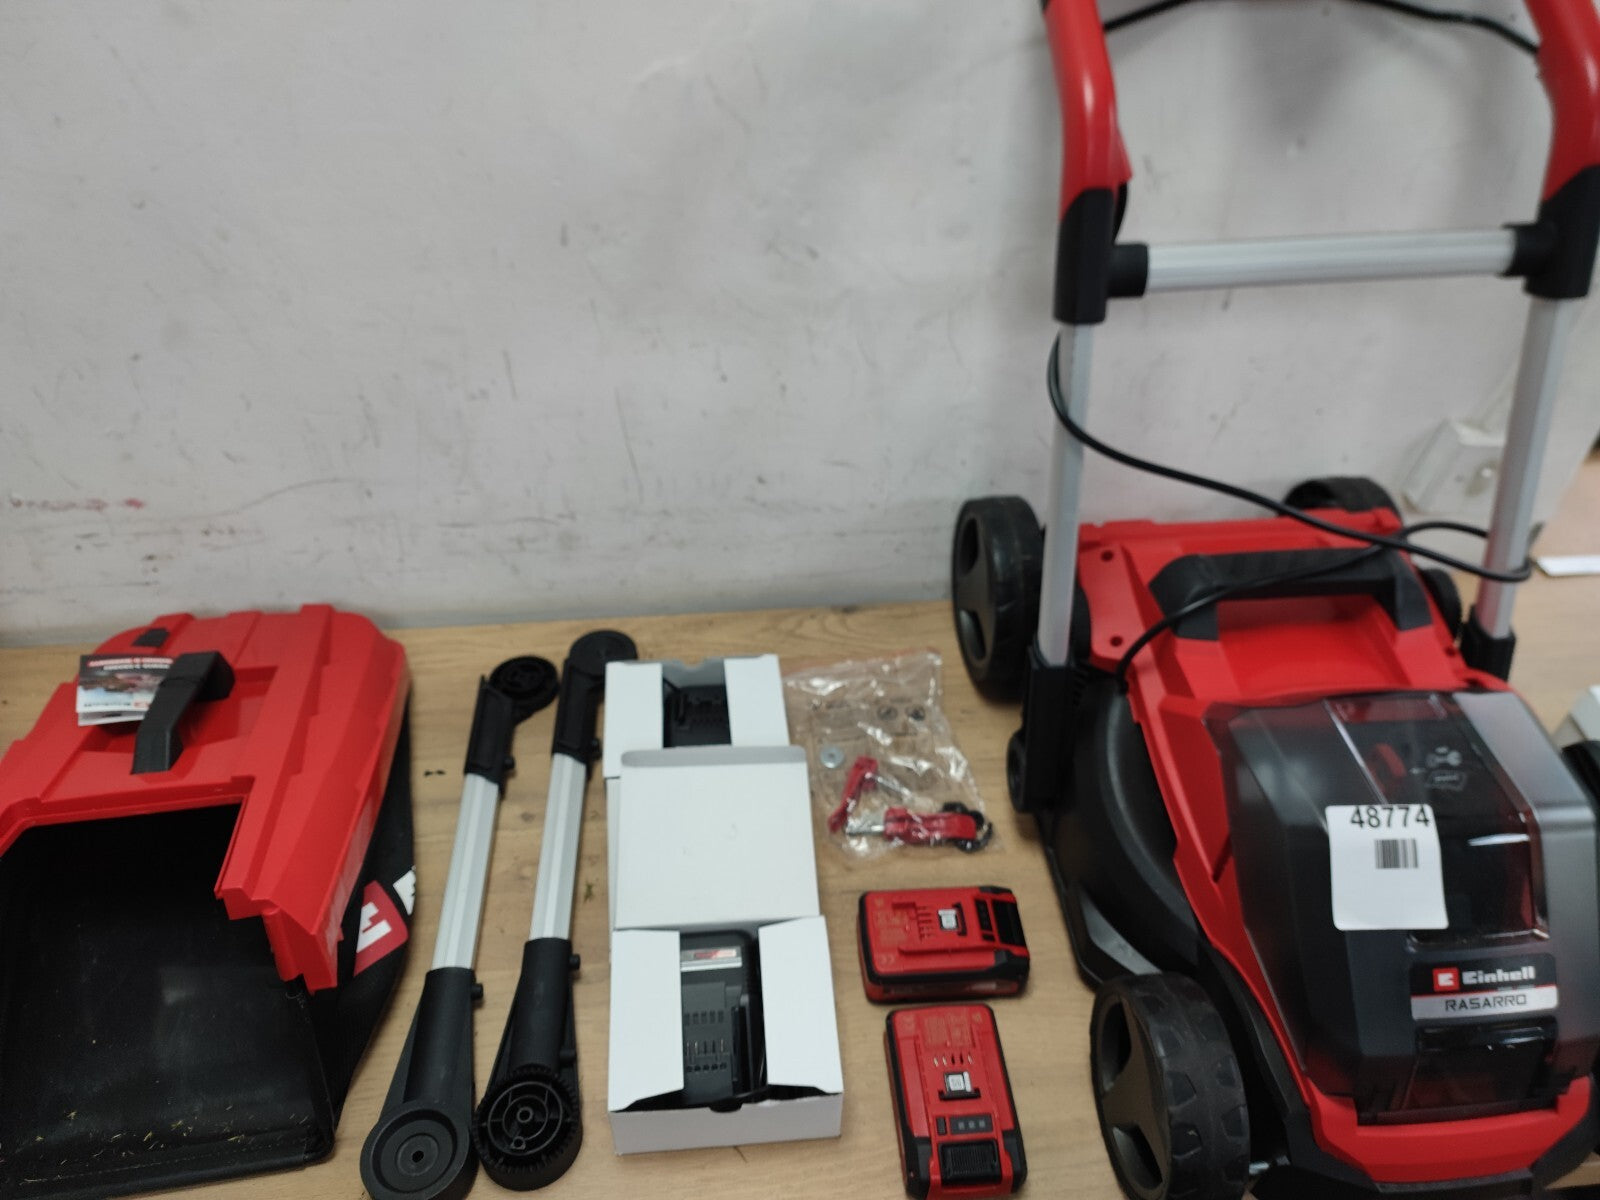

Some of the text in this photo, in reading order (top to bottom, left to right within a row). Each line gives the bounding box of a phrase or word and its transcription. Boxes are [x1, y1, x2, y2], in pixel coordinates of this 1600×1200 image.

[1350, 805, 1430, 828] 48774
[1461, 965, 1536, 985] Einhell
[1444, 993, 1527, 1012] RASARRO
